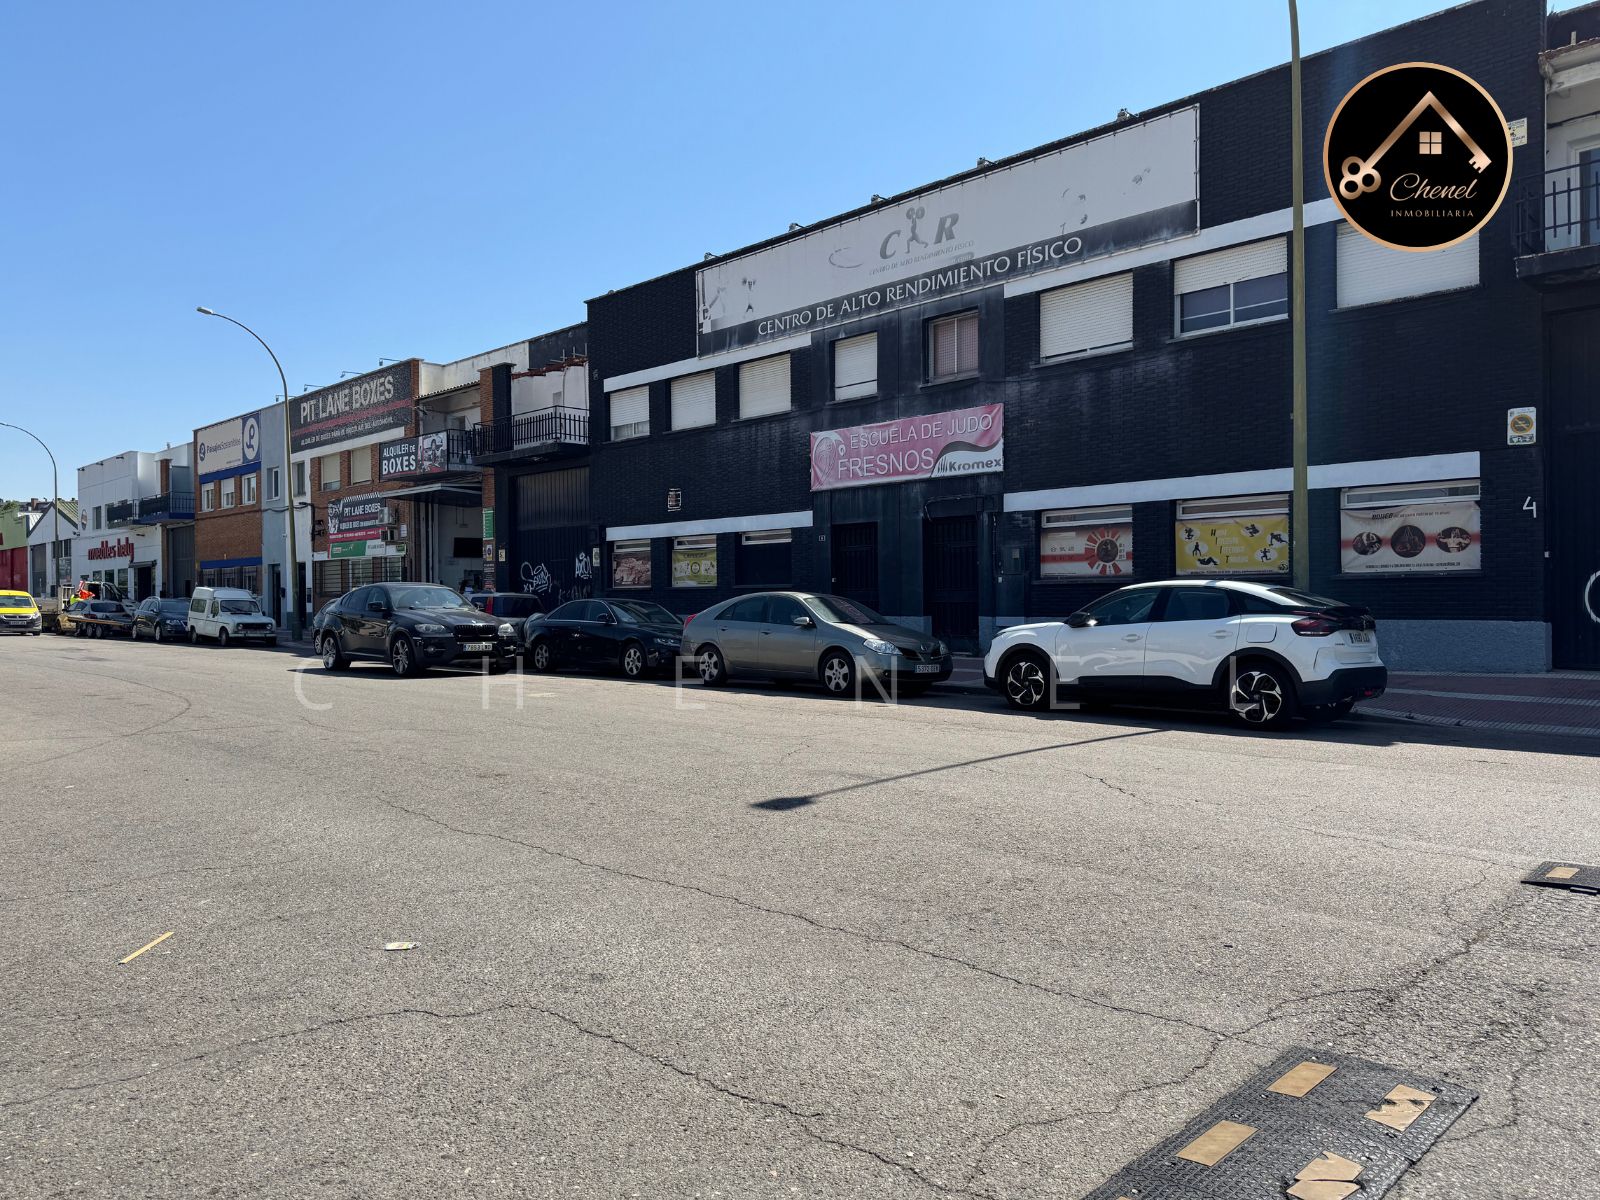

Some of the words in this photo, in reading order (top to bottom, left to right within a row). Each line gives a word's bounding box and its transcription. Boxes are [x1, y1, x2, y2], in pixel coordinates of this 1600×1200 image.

[758, 311, 812, 336] CENTRO
[816, 304, 835, 321] DE
[840, 291, 881, 315] ALTO
[886, 256, 1010, 301] RENDIMIENTO
[1017, 237, 1082, 269] FÍSICO
[300, 401, 316, 425] PIT
[319, 391, 352, 419] LANE
[352, 376, 394, 410] BOXES
[850, 426, 918, 449] ESCUELA
[920, 421, 942, 439] DE
[947, 413, 993, 436] JUDO
[382, 443, 409, 457] ALQUILER
[409, 444, 416, 453] DE
[382, 455, 416, 475] BOXES
[838, 447, 934, 479] FRESNOS
[949, 457, 1002, 473] Kromex
[343, 507, 352, 517] PIT
[351, 504, 364, 515] LANE
[364, 502, 381, 514] BOXES
[1522, 496, 1537, 518] 4
